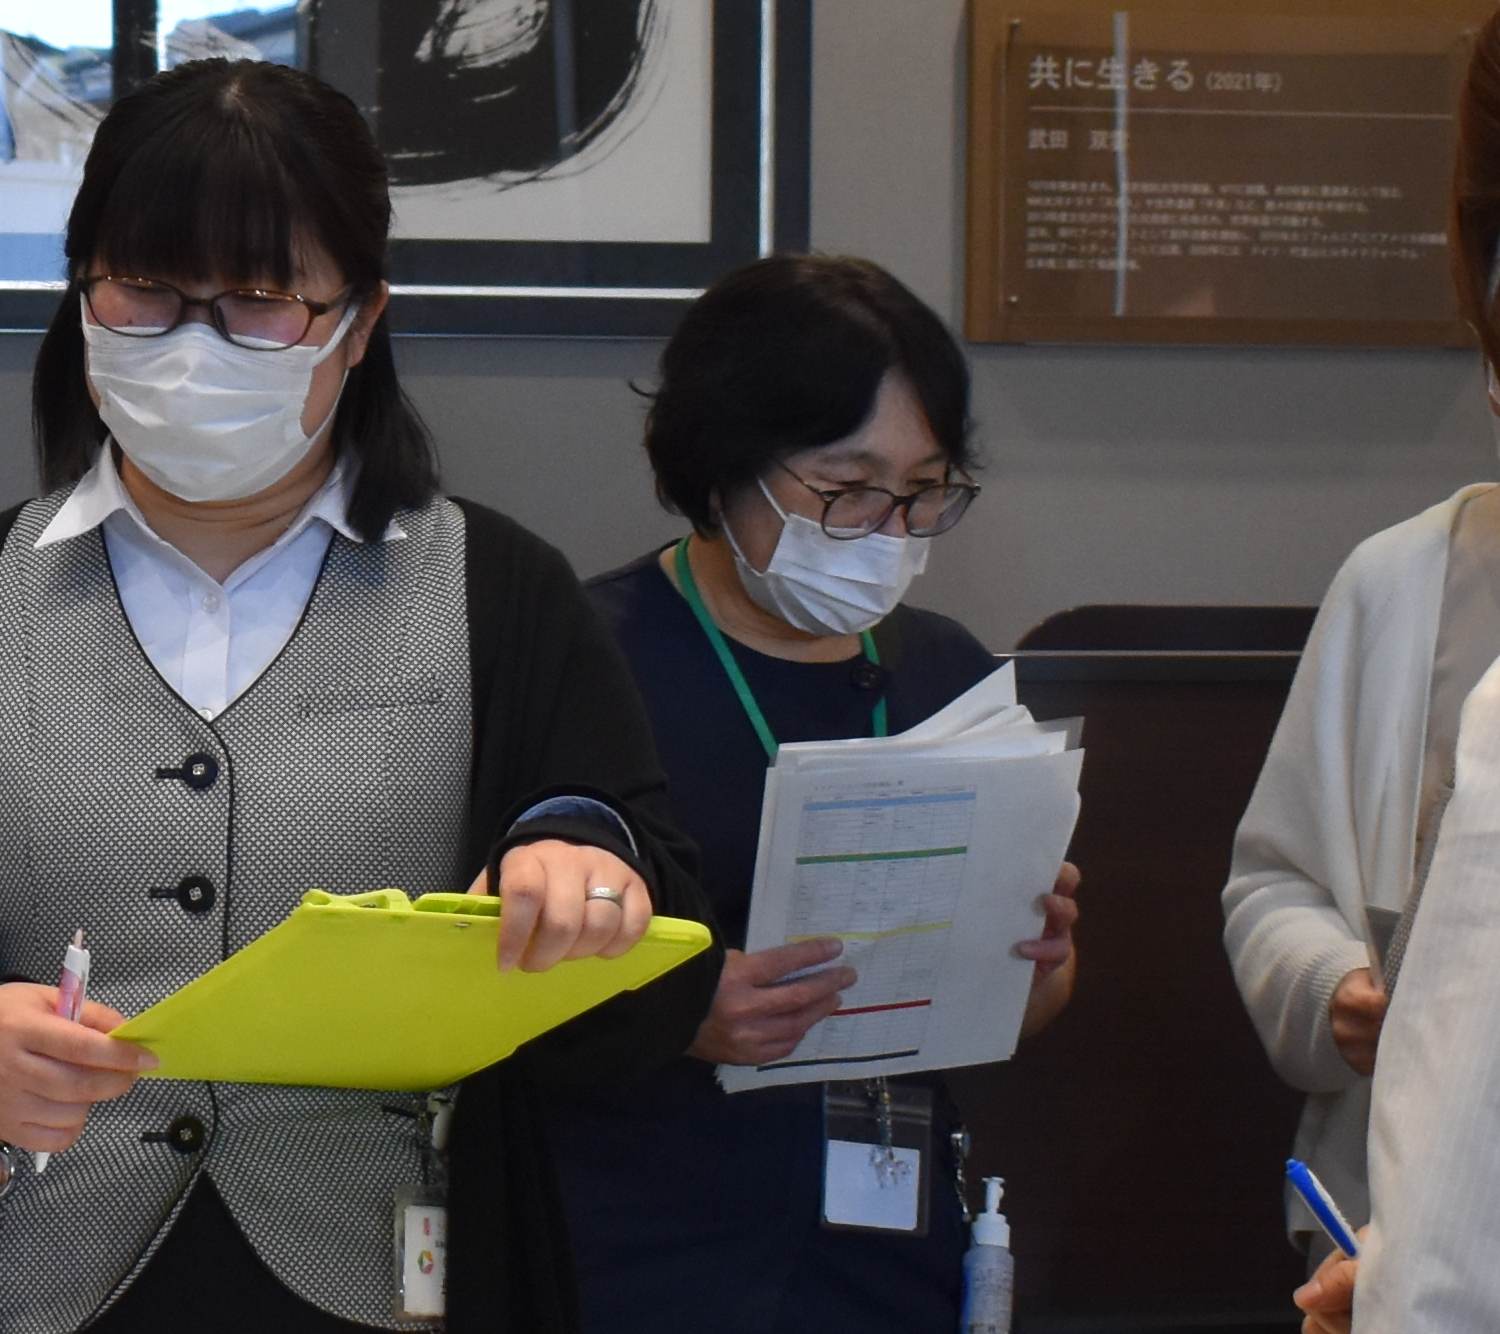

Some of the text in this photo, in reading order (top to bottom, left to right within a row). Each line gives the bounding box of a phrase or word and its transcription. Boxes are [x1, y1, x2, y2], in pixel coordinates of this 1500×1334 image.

[1029, 54, 1195, 92] 共に生きる
